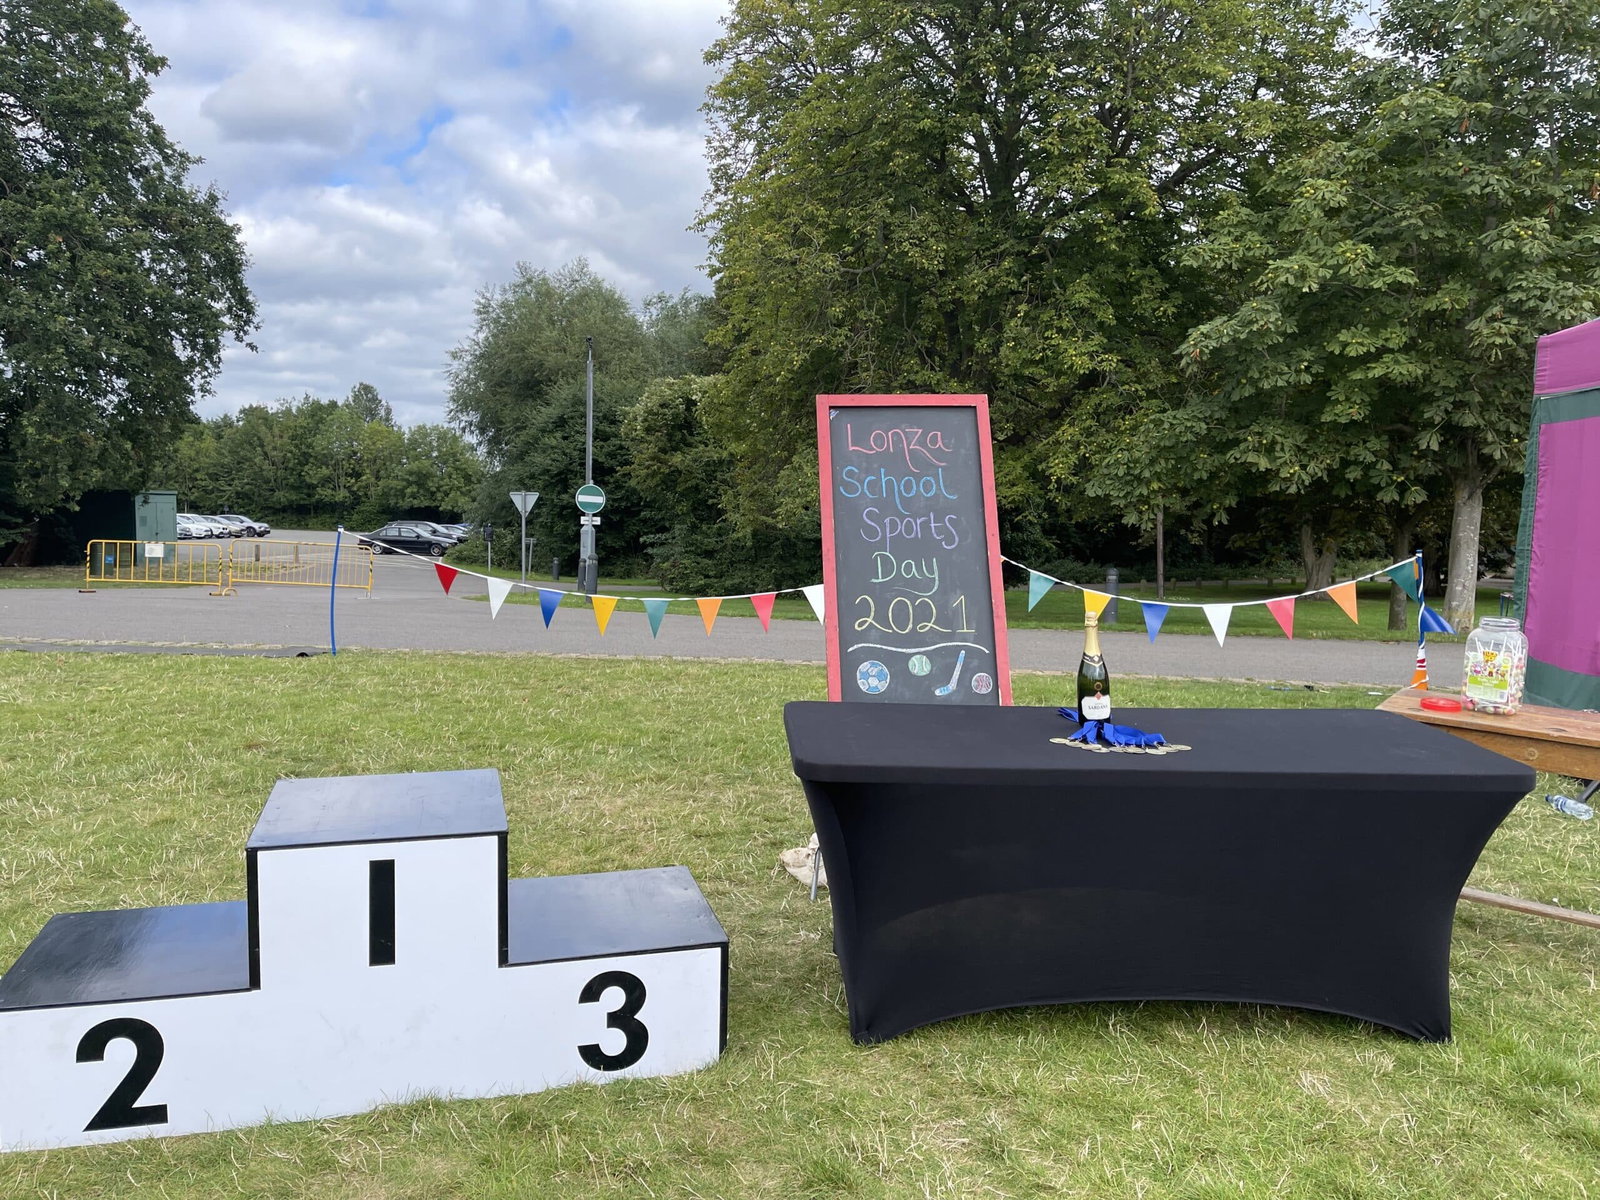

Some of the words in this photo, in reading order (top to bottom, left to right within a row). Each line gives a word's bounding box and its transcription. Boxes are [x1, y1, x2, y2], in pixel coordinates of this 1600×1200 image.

[847, 423, 953, 473] Lonza
[840, 466, 958, 514] School
[860, 507, 960, 553] Sports
[870, 551, 940, 596] Day
[854, 595, 976, 634] 2021
[577, 970, 649, 1072] 3
[75, 1017, 168, 1132] 2
